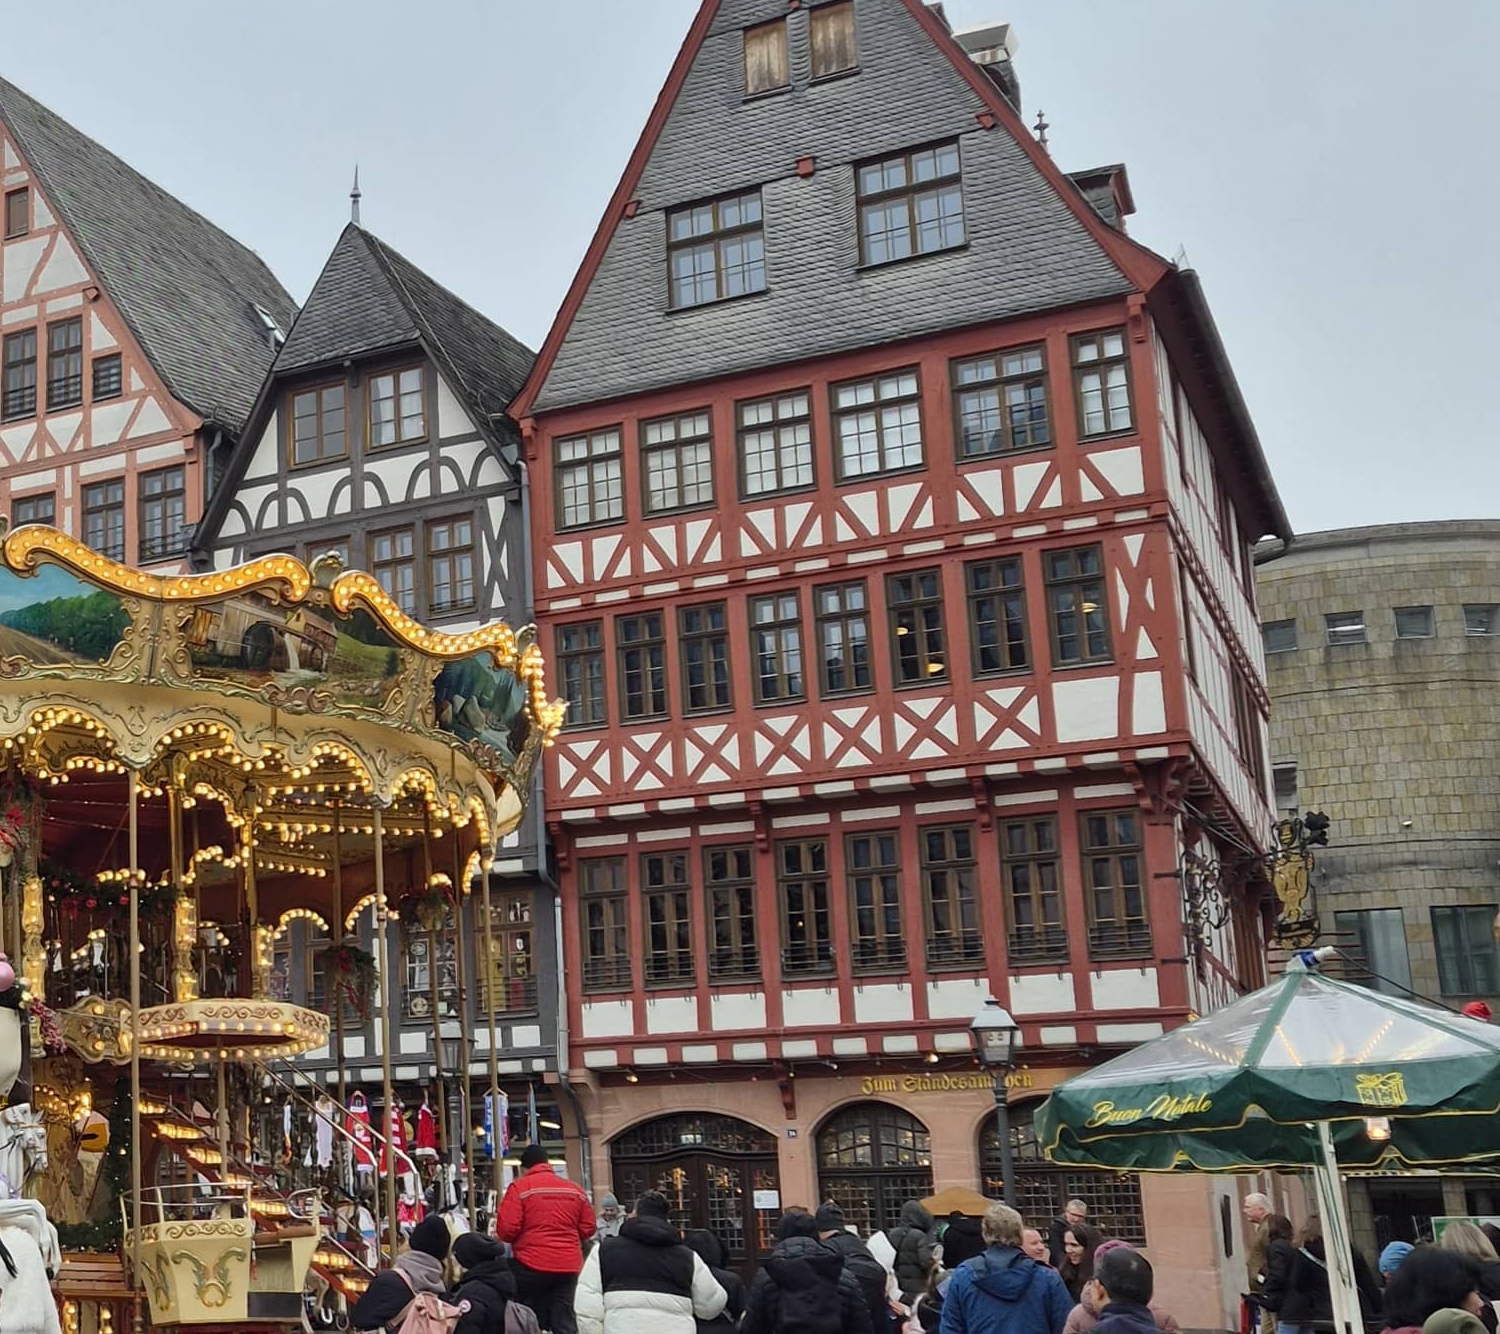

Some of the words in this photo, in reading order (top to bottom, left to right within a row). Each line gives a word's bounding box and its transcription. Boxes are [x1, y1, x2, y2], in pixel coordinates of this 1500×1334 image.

[861, 1075, 897, 1095] Zum
[1085, 1100, 1142, 1128] Buon
[1144, 1092, 1213, 1121] Natale
